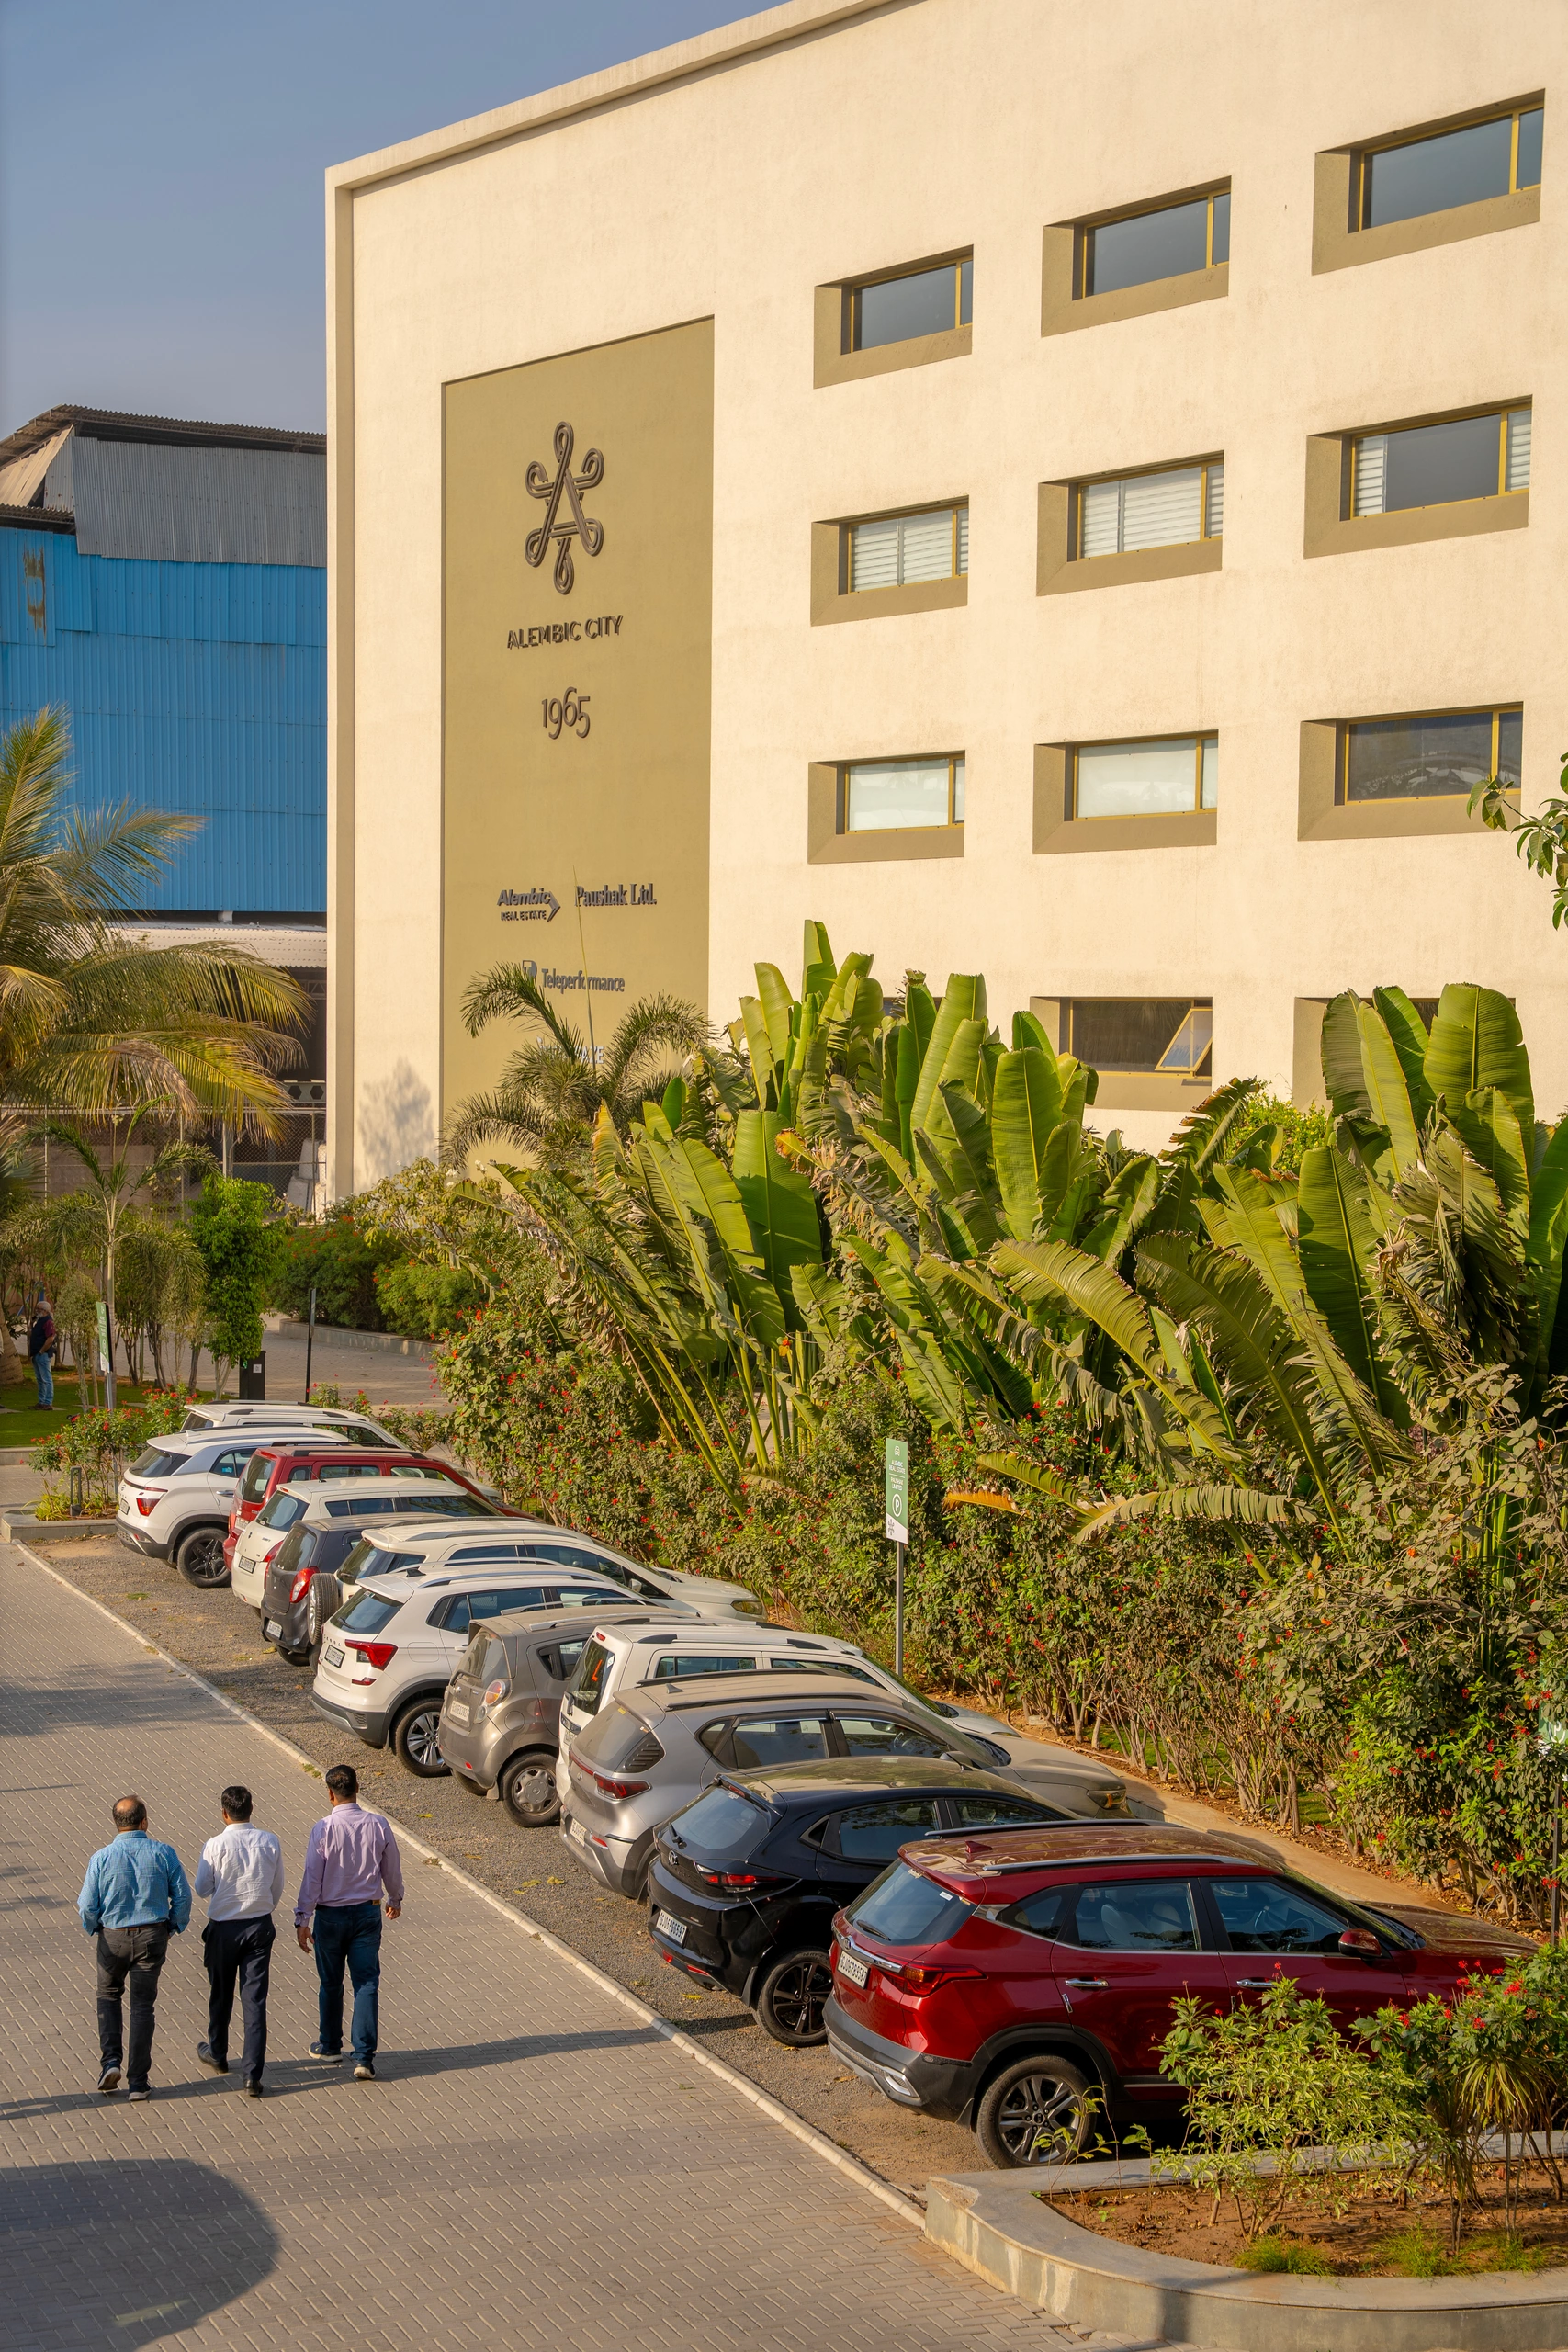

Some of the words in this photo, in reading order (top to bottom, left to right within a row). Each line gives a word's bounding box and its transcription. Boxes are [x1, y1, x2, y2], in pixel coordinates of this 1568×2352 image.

[507, 621, 581, 650] ALEMBIC
[584, 615, 624, 639] CITY
[541, 686, 591, 740] 1965
[497, 888, 551, 906] Alembic
[574, 884, 628, 907] Paushak
[630, 882, 658, 905] Ltd.
[501, 911, 519, 921] REAL
[520, 910, 547, 921] ESTATE
[541, 968, 626, 994] Teleperformance
[895, 1499, 899, 1511] P
